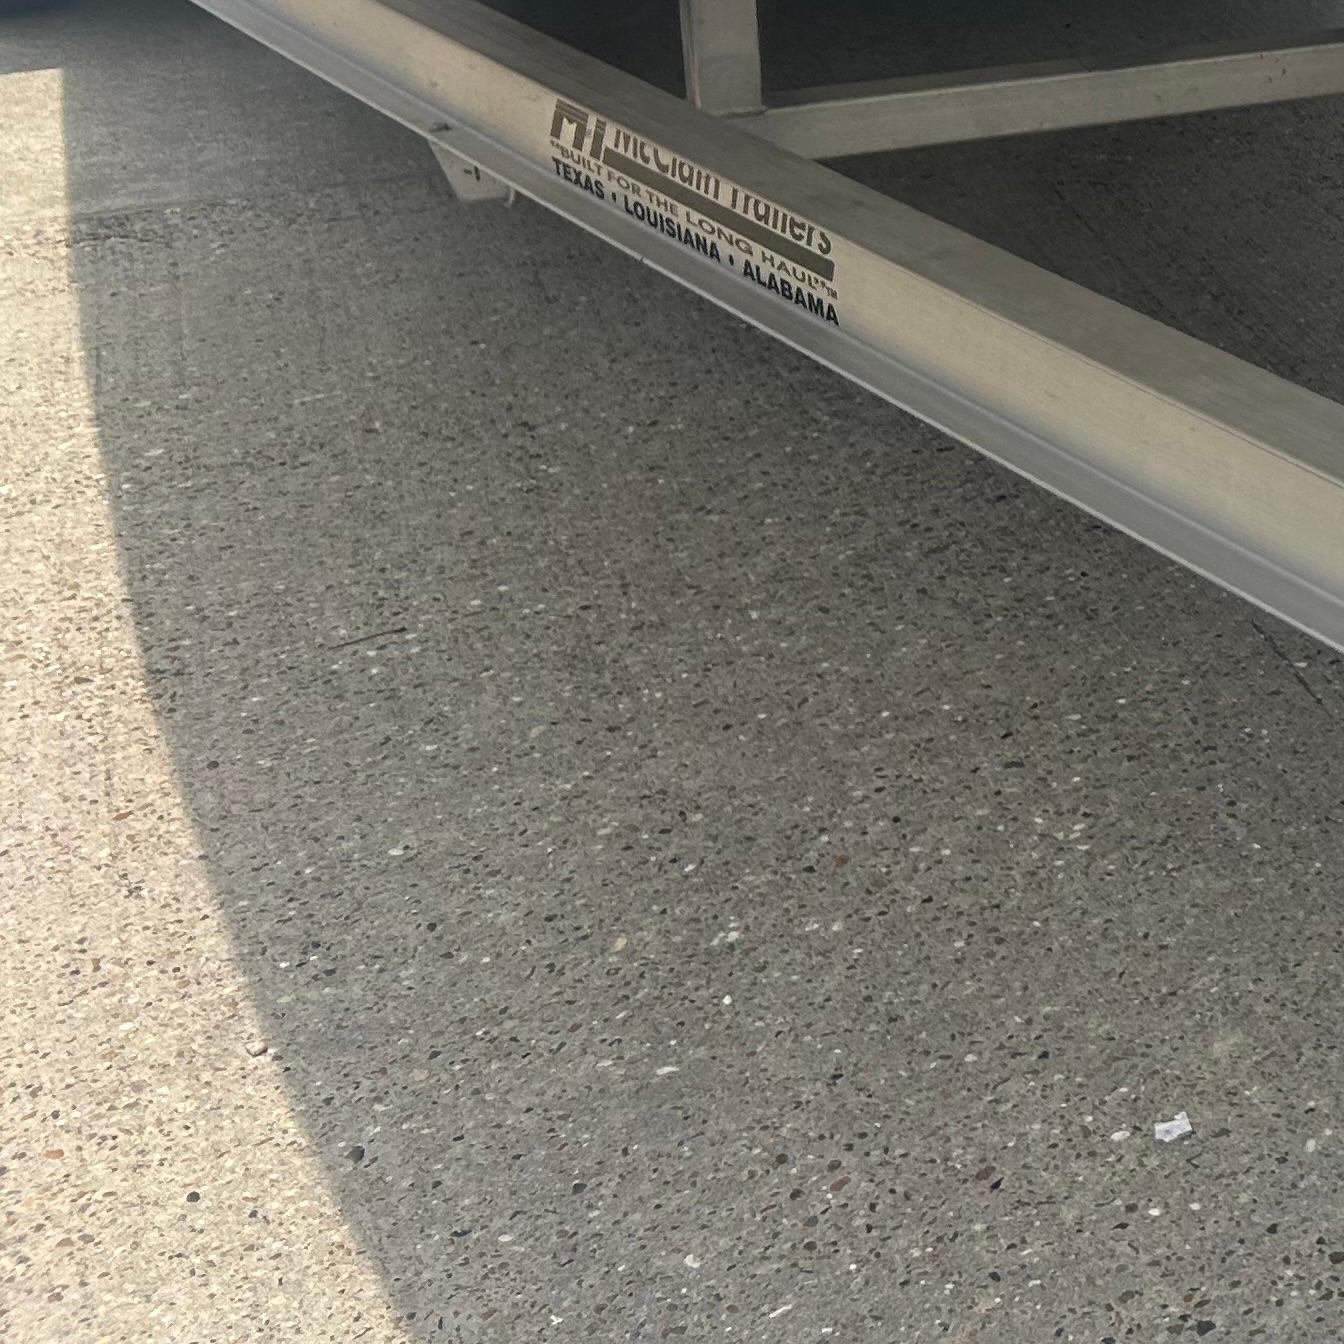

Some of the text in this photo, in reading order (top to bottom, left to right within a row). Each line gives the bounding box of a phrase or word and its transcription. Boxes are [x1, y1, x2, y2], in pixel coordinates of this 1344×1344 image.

[551, 156, 840, 328] TEXAS LOUISIANA ALABAMA
[607, 170, 642, 199] FOR
[645, 189, 680, 218] THE
[685, 210, 754, 257] LONG
